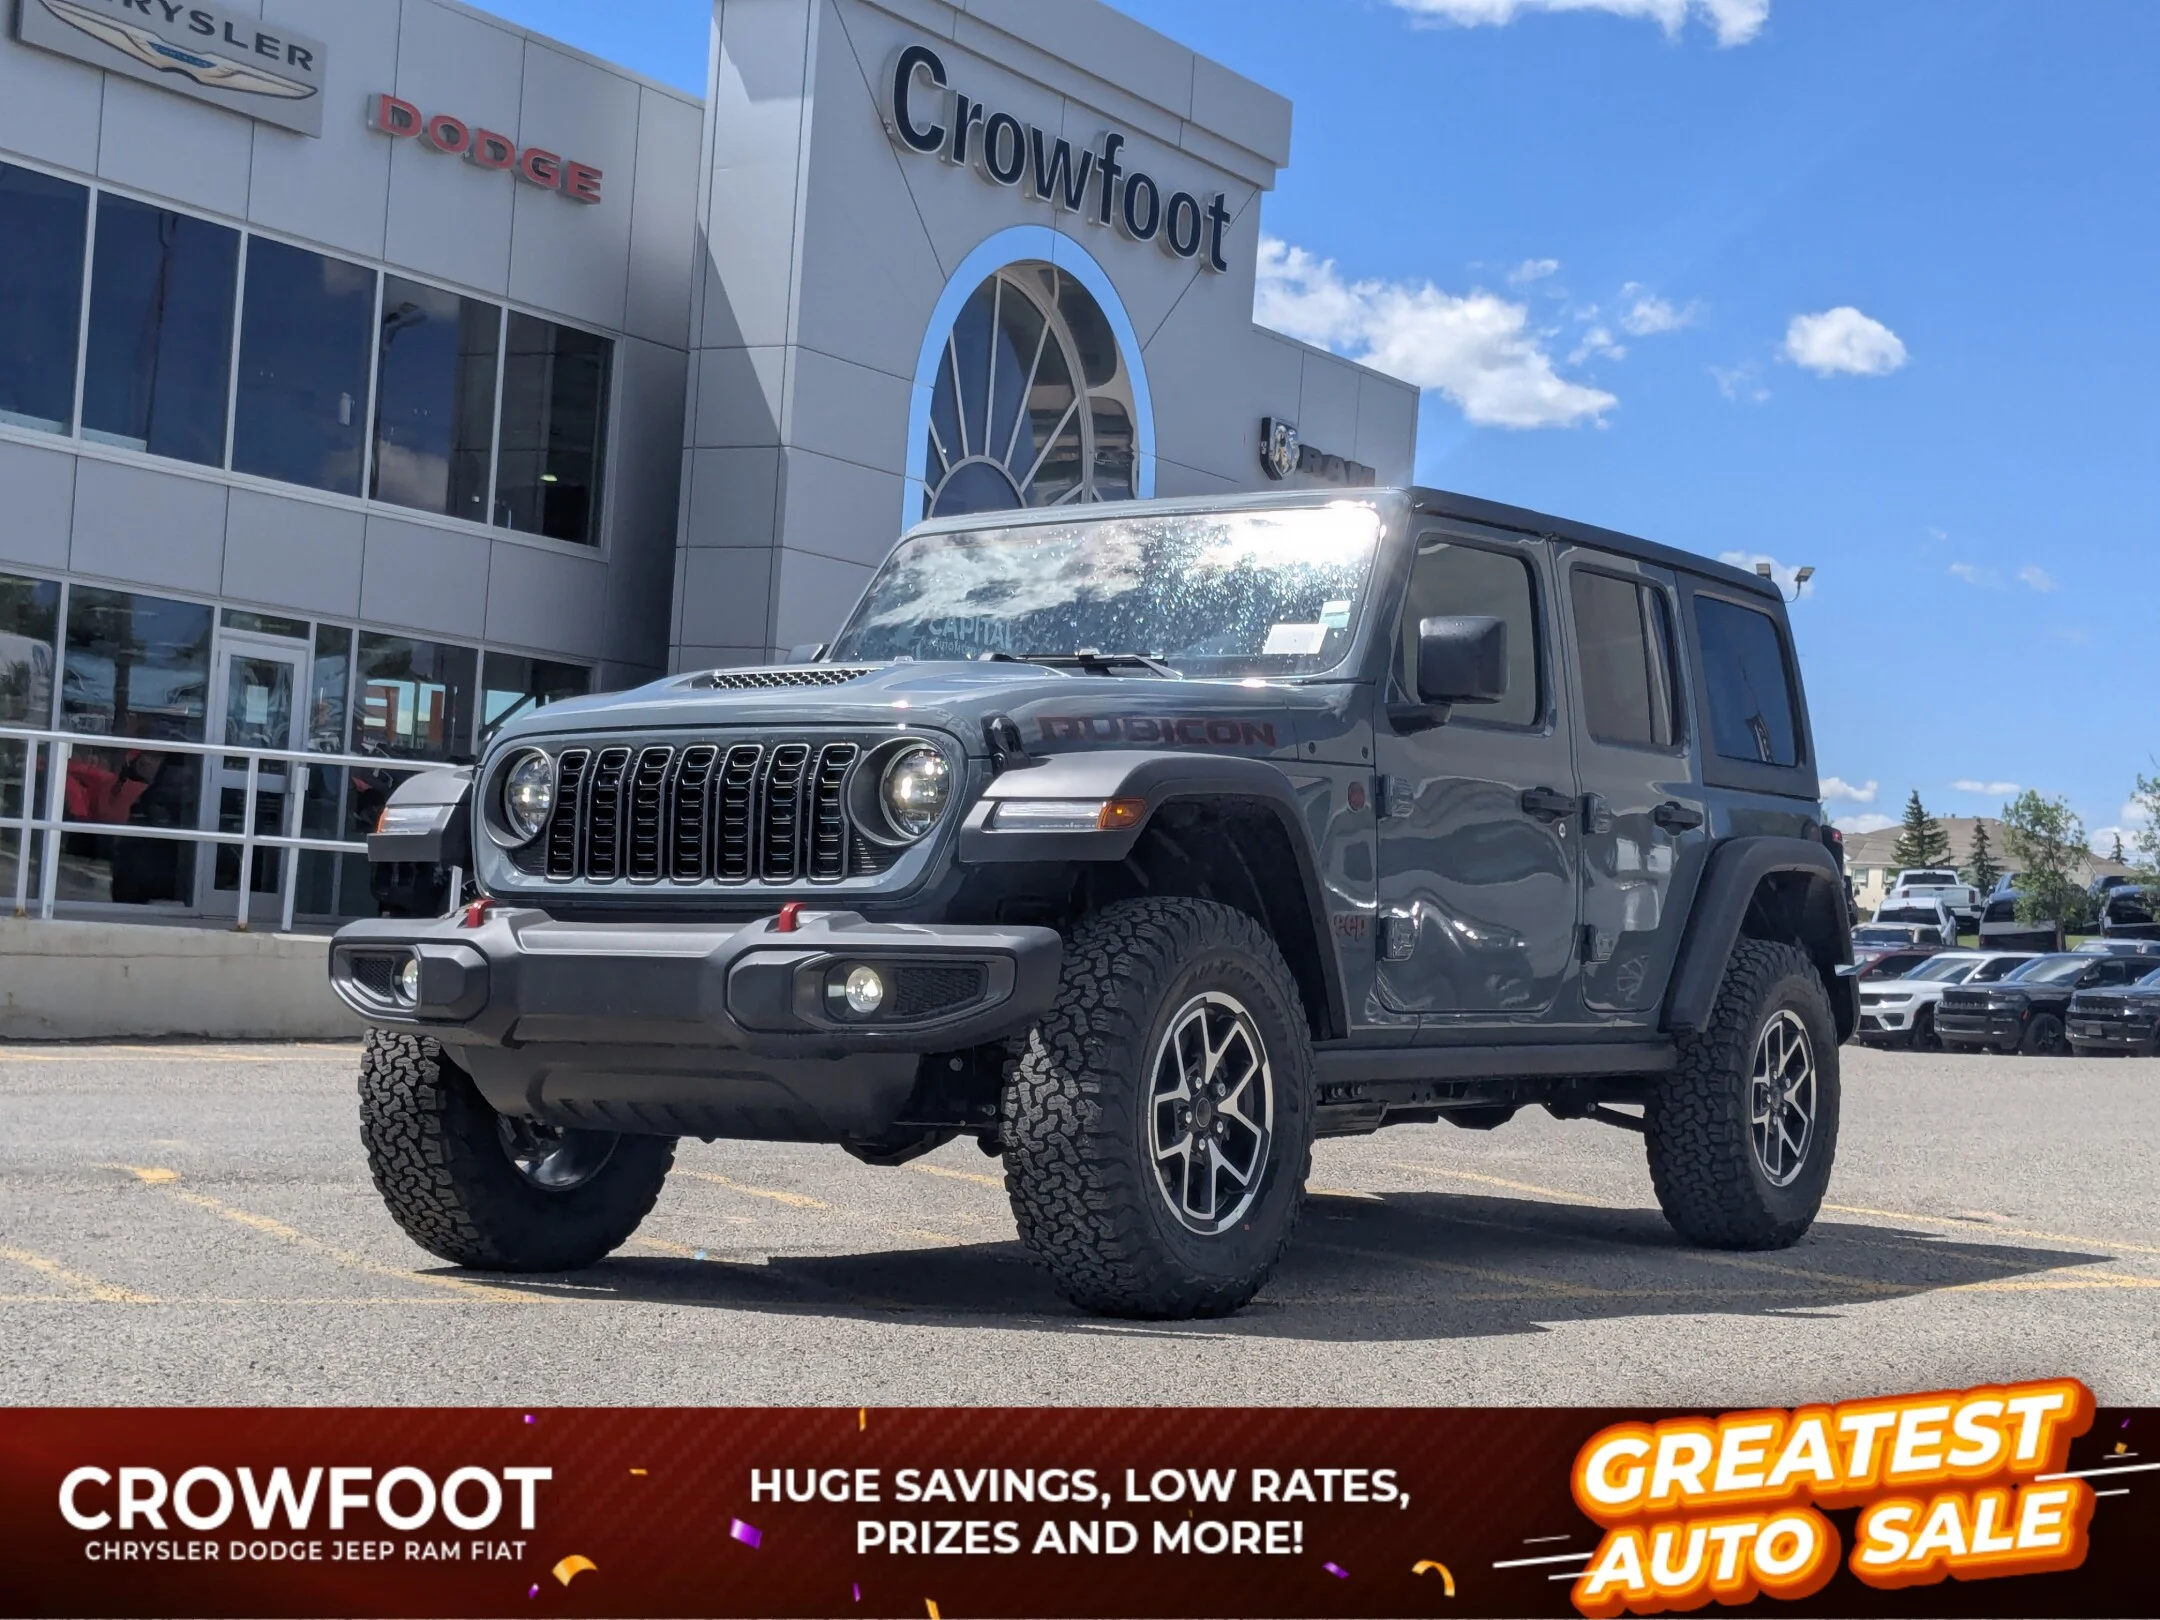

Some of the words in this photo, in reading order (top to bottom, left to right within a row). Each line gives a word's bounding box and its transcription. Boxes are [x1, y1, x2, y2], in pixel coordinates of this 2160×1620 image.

[106, 0, 314, 72] RYSLER
[378, 94, 604, 205] DODGE
[891, 44, 1231, 274] Crowfoot
[1036, 715, 1277, 748] RUBICON
[1332, 913, 1367, 942] eep
